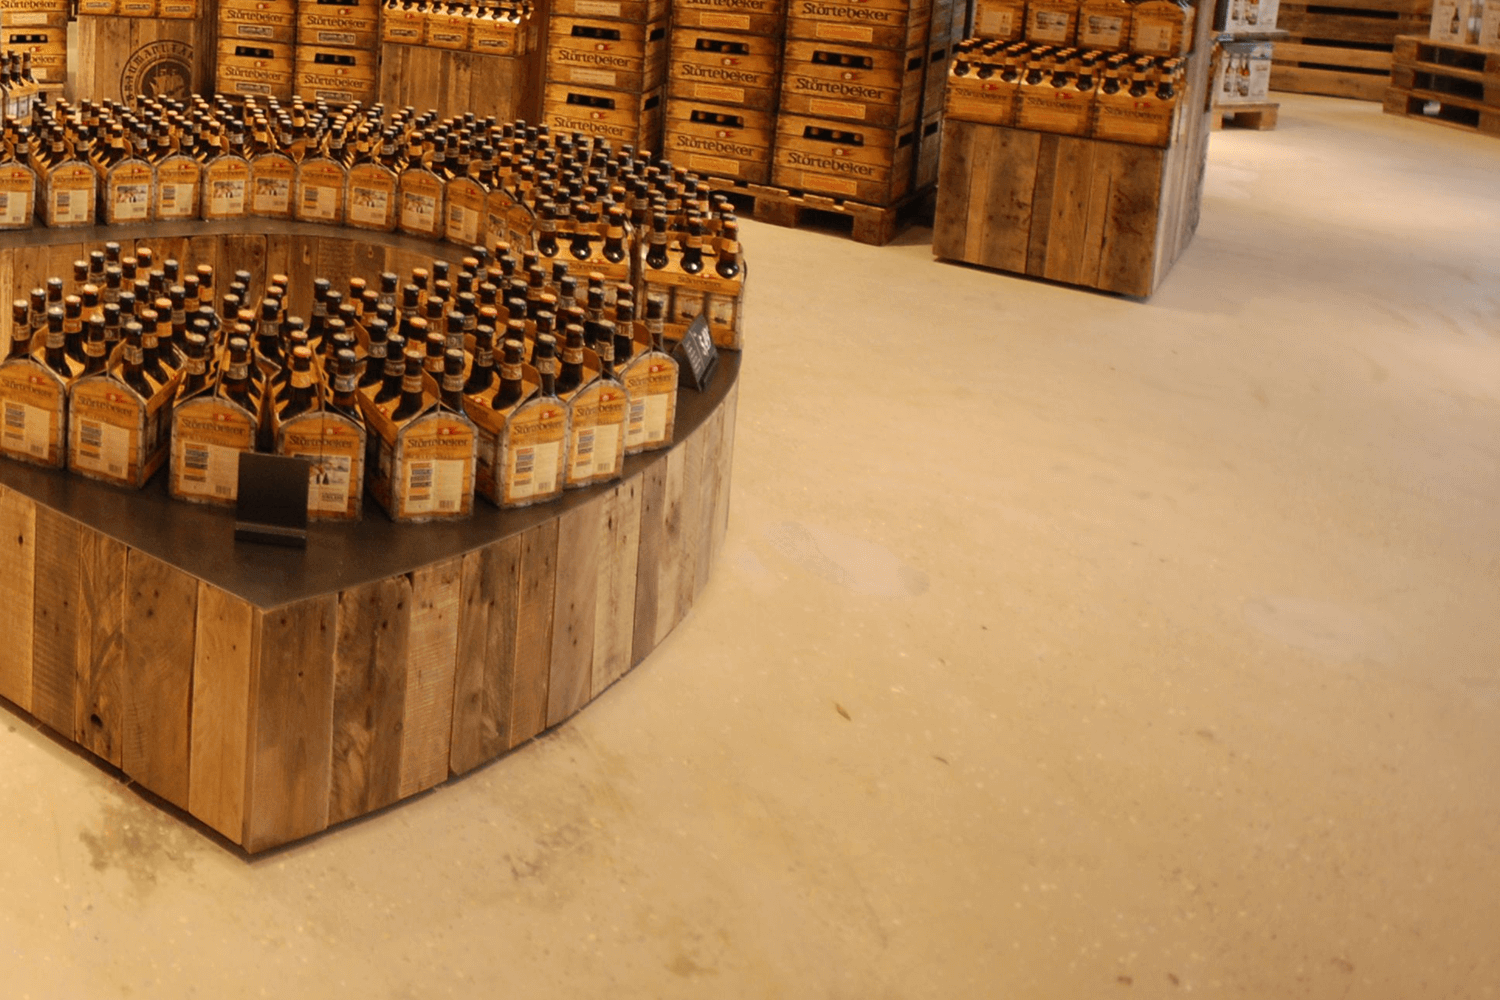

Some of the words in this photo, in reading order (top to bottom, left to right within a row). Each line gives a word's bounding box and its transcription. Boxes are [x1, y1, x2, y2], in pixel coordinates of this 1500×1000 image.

[1, 0, 58, 10] Störtebeker
[802, 2, 891, 21] Störtebeker
[227, 10, 284, 23] Störtebeker
[306, 15, 368, 29] Störtebeker
[558, 50, 631, 68] Störtebeker
[225, 67, 282, 81] Störtebeker
[304, 75, 365, 90] Störtebeker
[681, 64, 760, 84] Störtebeker
[795, 77, 885, 100] Störtebeker
[554, 117, 626, 137] Störtebeker
[676, 135, 754, 156] Störtebeker
[787, 151, 876, 177] Störtebeker
[181, 418, 246, 436] Störtebeker
[288, 434, 354, 449] Störtebeker
[407, 437, 469, 450] Störtebeker
